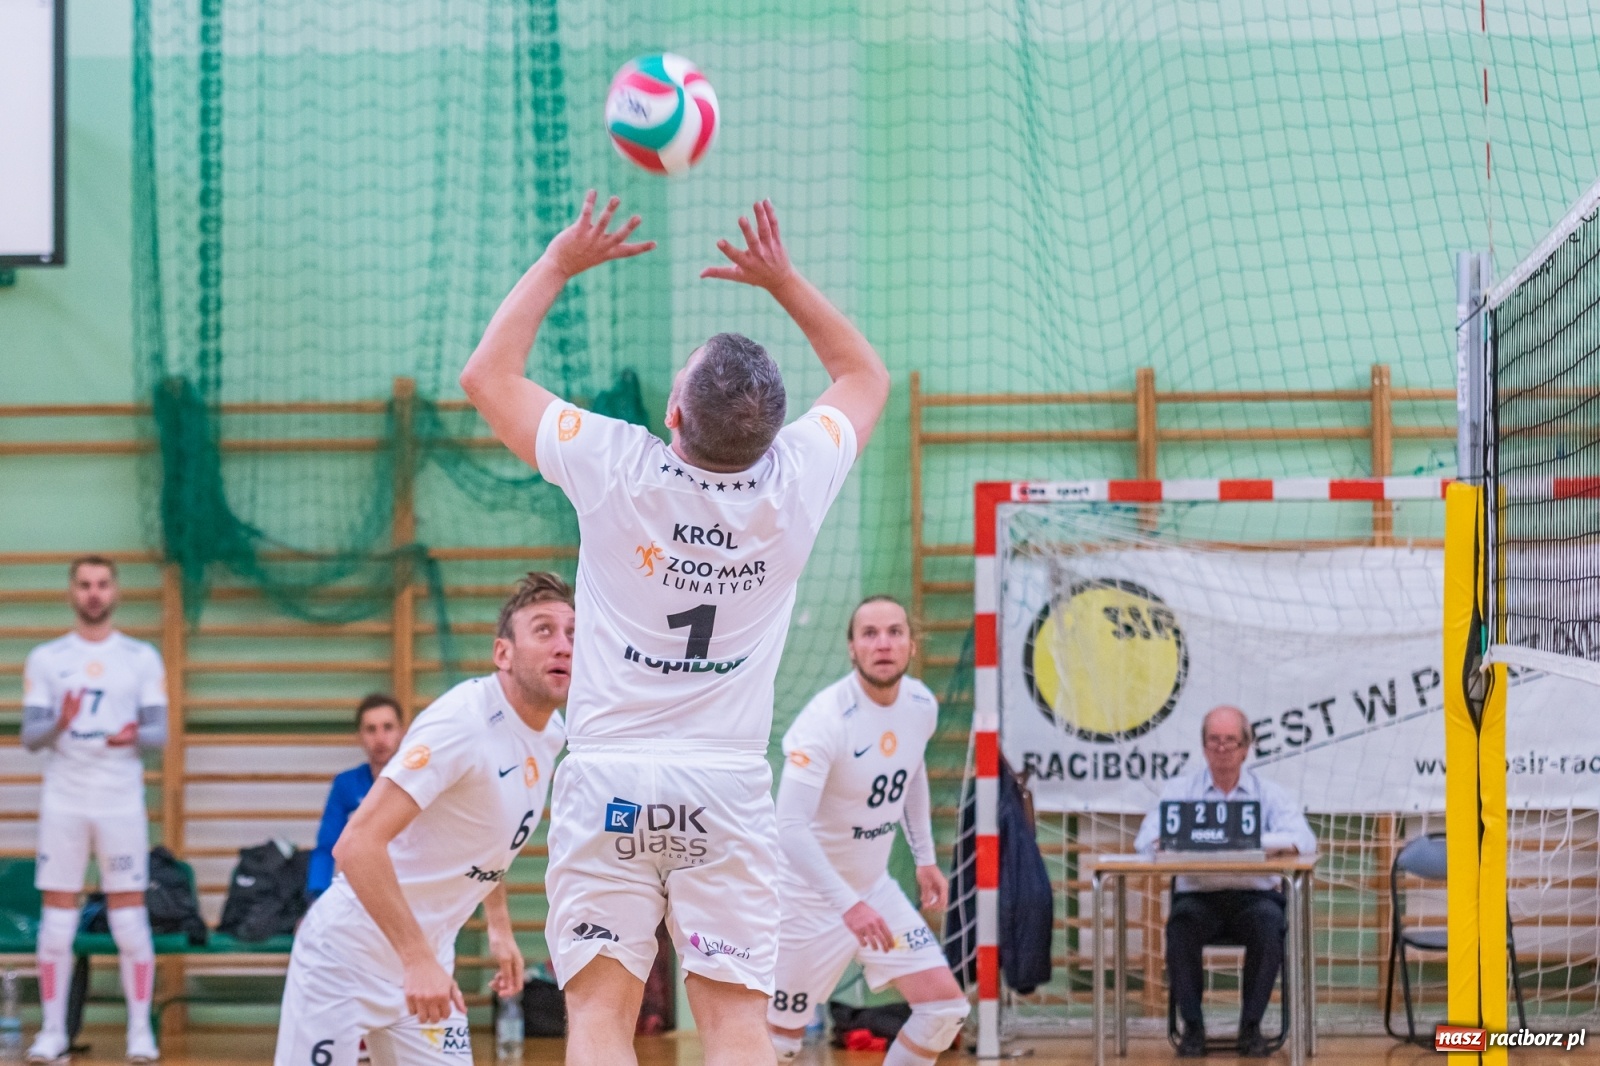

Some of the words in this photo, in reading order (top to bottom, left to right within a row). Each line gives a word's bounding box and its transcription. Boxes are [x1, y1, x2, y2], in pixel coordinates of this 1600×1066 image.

[673, 523, 738, 550] KRÓL
[667, 556, 766, 580] ZOO-MAR
[662, 573, 766, 595] LUNATYCY
[667, 604, 717, 660] 1
[1353, 677, 1398, 725] W
[1412, 665, 1443, 708] P
[866, 768, 908, 809] 88
[509, 809, 535, 851] 6
[646, 803, 708, 834] DK
[1165, 804, 1181, 835] 5
[1194, 802, 1207, 824] 2
[1216, 802, 1228, 824] 0
[1241, 804, 1256, 836] 5
[615, 829, 708, 860] glass
[773, 989, 808, 1014] 88
[311, 1039, 335, 1066] 6
